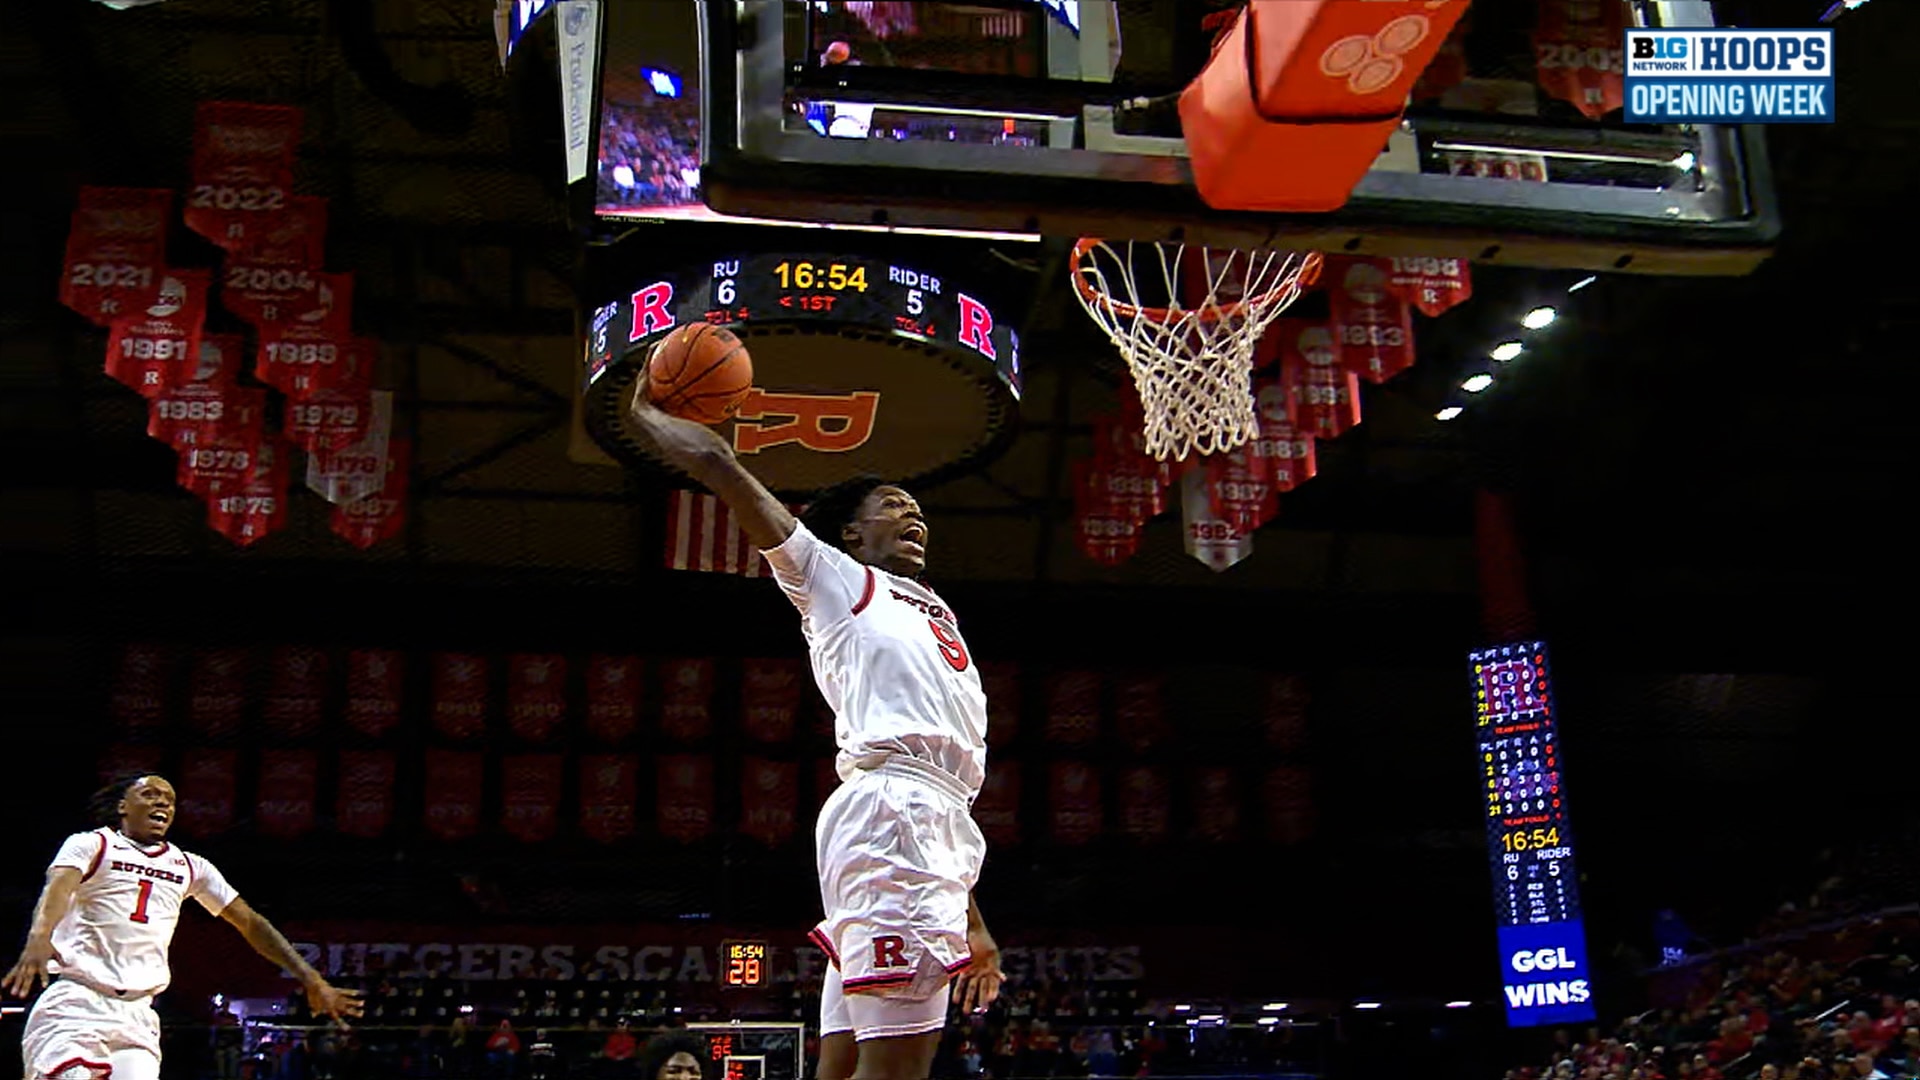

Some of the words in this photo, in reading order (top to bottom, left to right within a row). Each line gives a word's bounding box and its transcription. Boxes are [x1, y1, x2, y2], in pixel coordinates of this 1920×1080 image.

[191, 184, 285, 211] 2022
[71, 264, 153, 287] 2021
[225, 267, 316, 291] 2004
[713, 260, 740, 278] RU
[774, 262, 868, 292] 16:54
[889, 266, 941, 294] RIDER
[717, 279, 736, 305] 6
[799, 295, 836, 311] 1ST
[906, 289, 924, 315] 5
[629, 281, 675, 342] R
[957, 292, 997, 361] R
[120, 338, 188, 360] 1991
[597, 326, 608, 353] 5
[144, 371, 159, 385] R
[158, 401, 224, 420] 1983
[292, 404, 359, 425] 1979
[219, 497, 276, 514] 1975
[928, 619, 969, 673] 9
[1502, 827, 1560, 852] 16:54
[1503, 852, 1520, 864] RU
[1536, 846, 1571, 860] RIDER
[111, 860, 184, 885] RUTGERS
[1507, 865, 1519, 881] 6
[1548, 860, 1560, 877] 5
[129, 878, 154, 924] 1
[730, 945, 764, 959] 16:54
[873, 936, 909, 969] R
[1511, 947, 1576, 973] GGL
[729, 959, 760, 985] 28
[1504, 979, 1591, 1008] WINS
